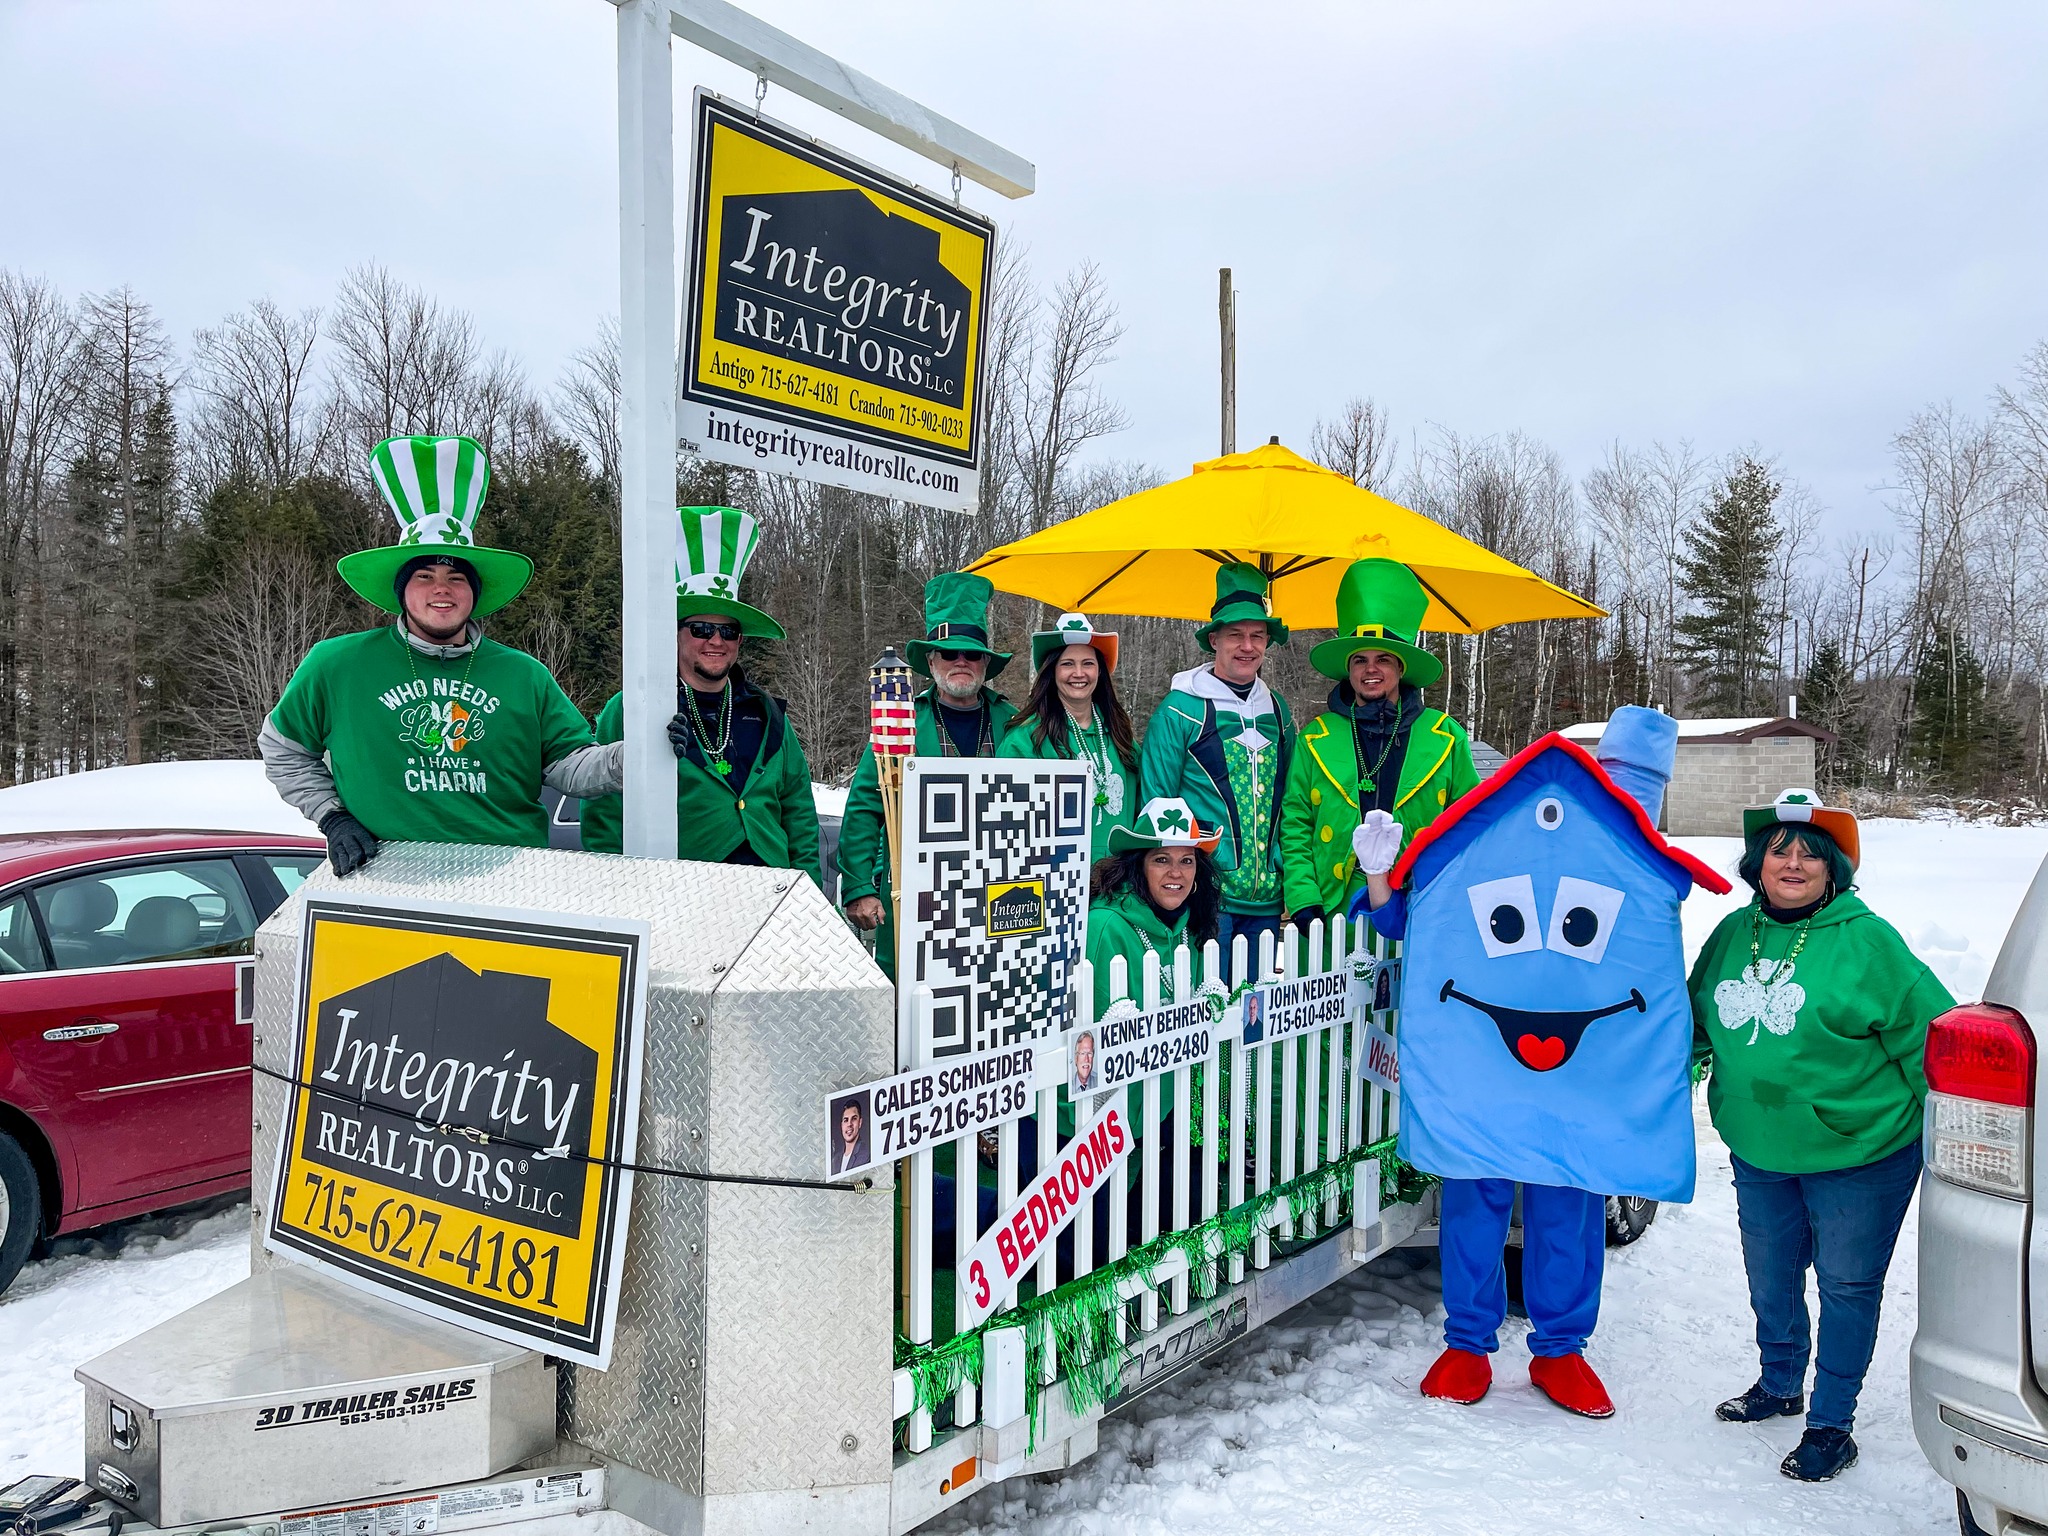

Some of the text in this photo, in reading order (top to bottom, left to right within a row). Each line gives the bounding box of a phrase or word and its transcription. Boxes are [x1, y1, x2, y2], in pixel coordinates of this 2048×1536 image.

[729, 206, 962, 358] Integrity
[709, 351, 964, 440] Antigo 715-627-4181 Crandon 715-902-0233
[925, 371, 955, 396] LLC
[707, 411, 960, 494] integrityrealtorsllc.com
[378, 678, 501, 714] WHO NEEDS
[404, 769, 487, 794] CHARM
[419, 756, 469, 769] I HAVE
[992, 900, 1040, 919] Integrity
[1269, 973, 1347, 1011] JOHN NEDDEN
[1269, 997, 1345, 1036] 715-610-4891
[1101, 1000, 1212, 1050] KENNEY BEHRENS
[1104, 1029, 1209, 1084] 920-428-2480
[320, 1008, 580, 1159] Integrity
[874, 1048, 1033, 1117] CALEB SCHNEIDER
[880, 1080, 1026, 1155] 715-216-5136
[515, 1182, 564, 1219] LLC
[969, 1109, 1125, 1309] 3 BEDROOMS
[303, 1171, 559, 1309] 715-627-4181
[256, 1378, 476, 1426] 3D TRAILER SALES
[340, 1400, 446, 1426] 563-503-1375
